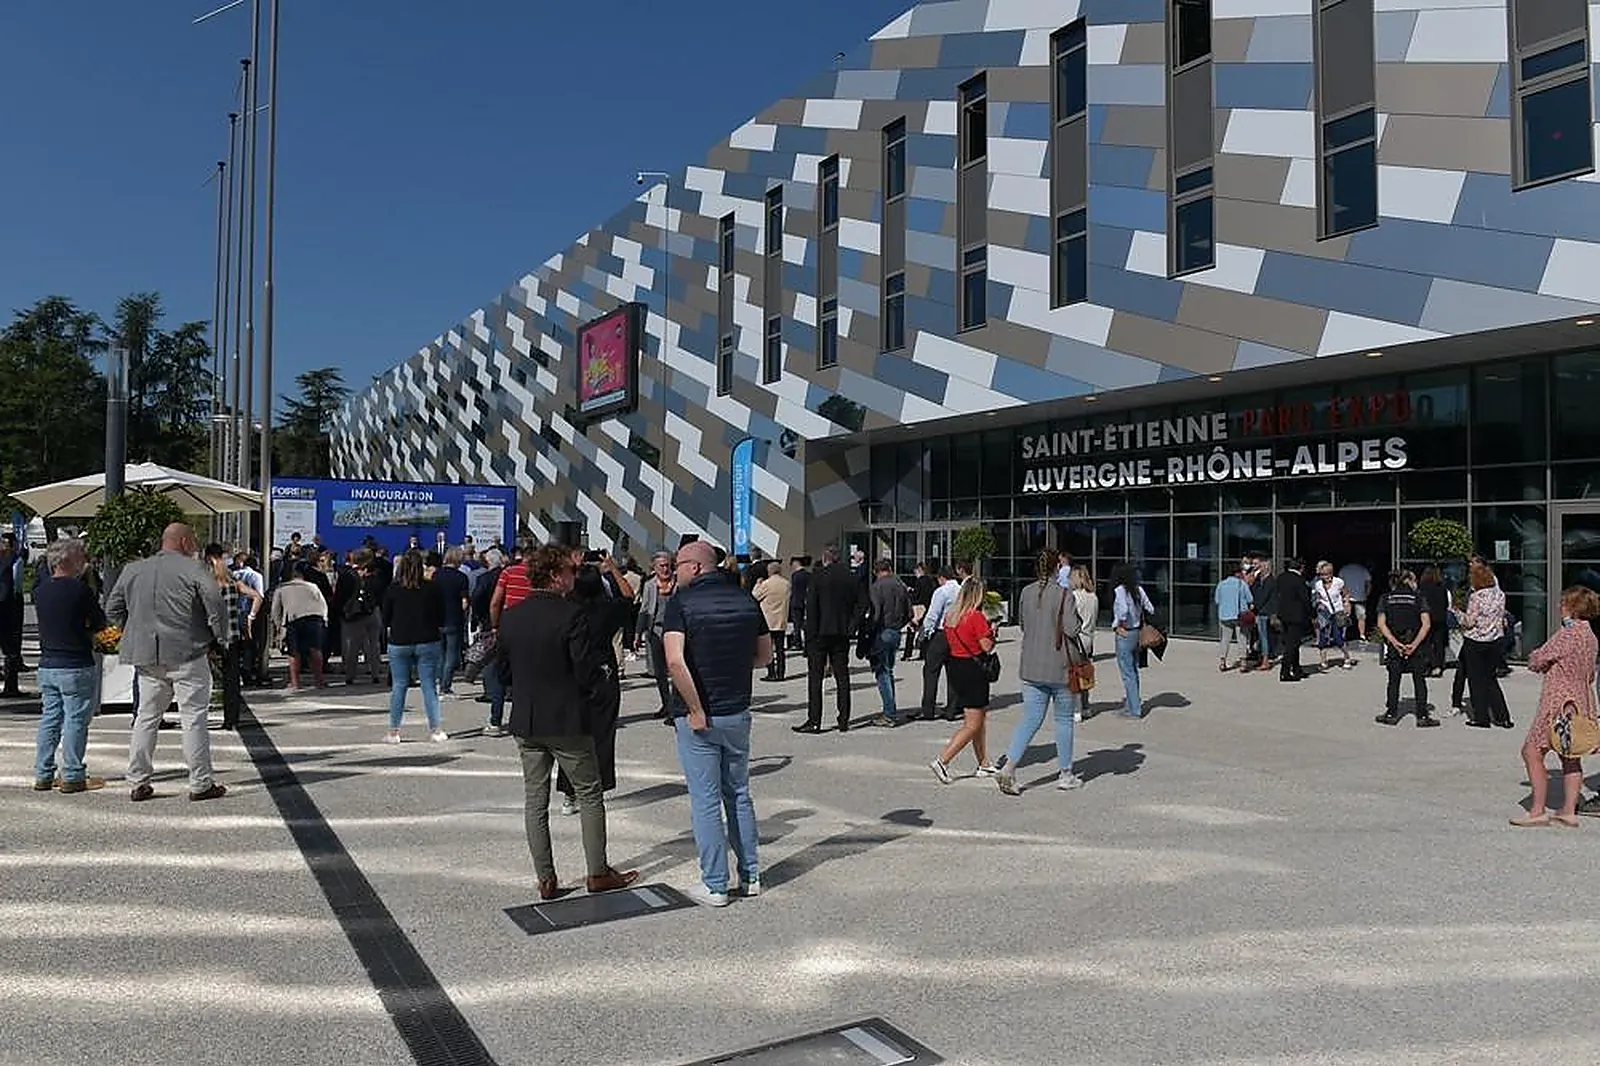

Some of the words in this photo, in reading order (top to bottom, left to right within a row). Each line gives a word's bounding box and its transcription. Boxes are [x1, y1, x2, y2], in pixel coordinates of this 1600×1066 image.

[1021, 411, 1229, 460] SAINT-ÉTIENNE
[1241, 402, 1313, 436] PARC
[1330, 391, 1410, 429] EXPO
[1022, 437, 1409, 493] AUVERGNE-RHÔNE-ALPES
[351, 488, 433, 502] INAUGURATION
